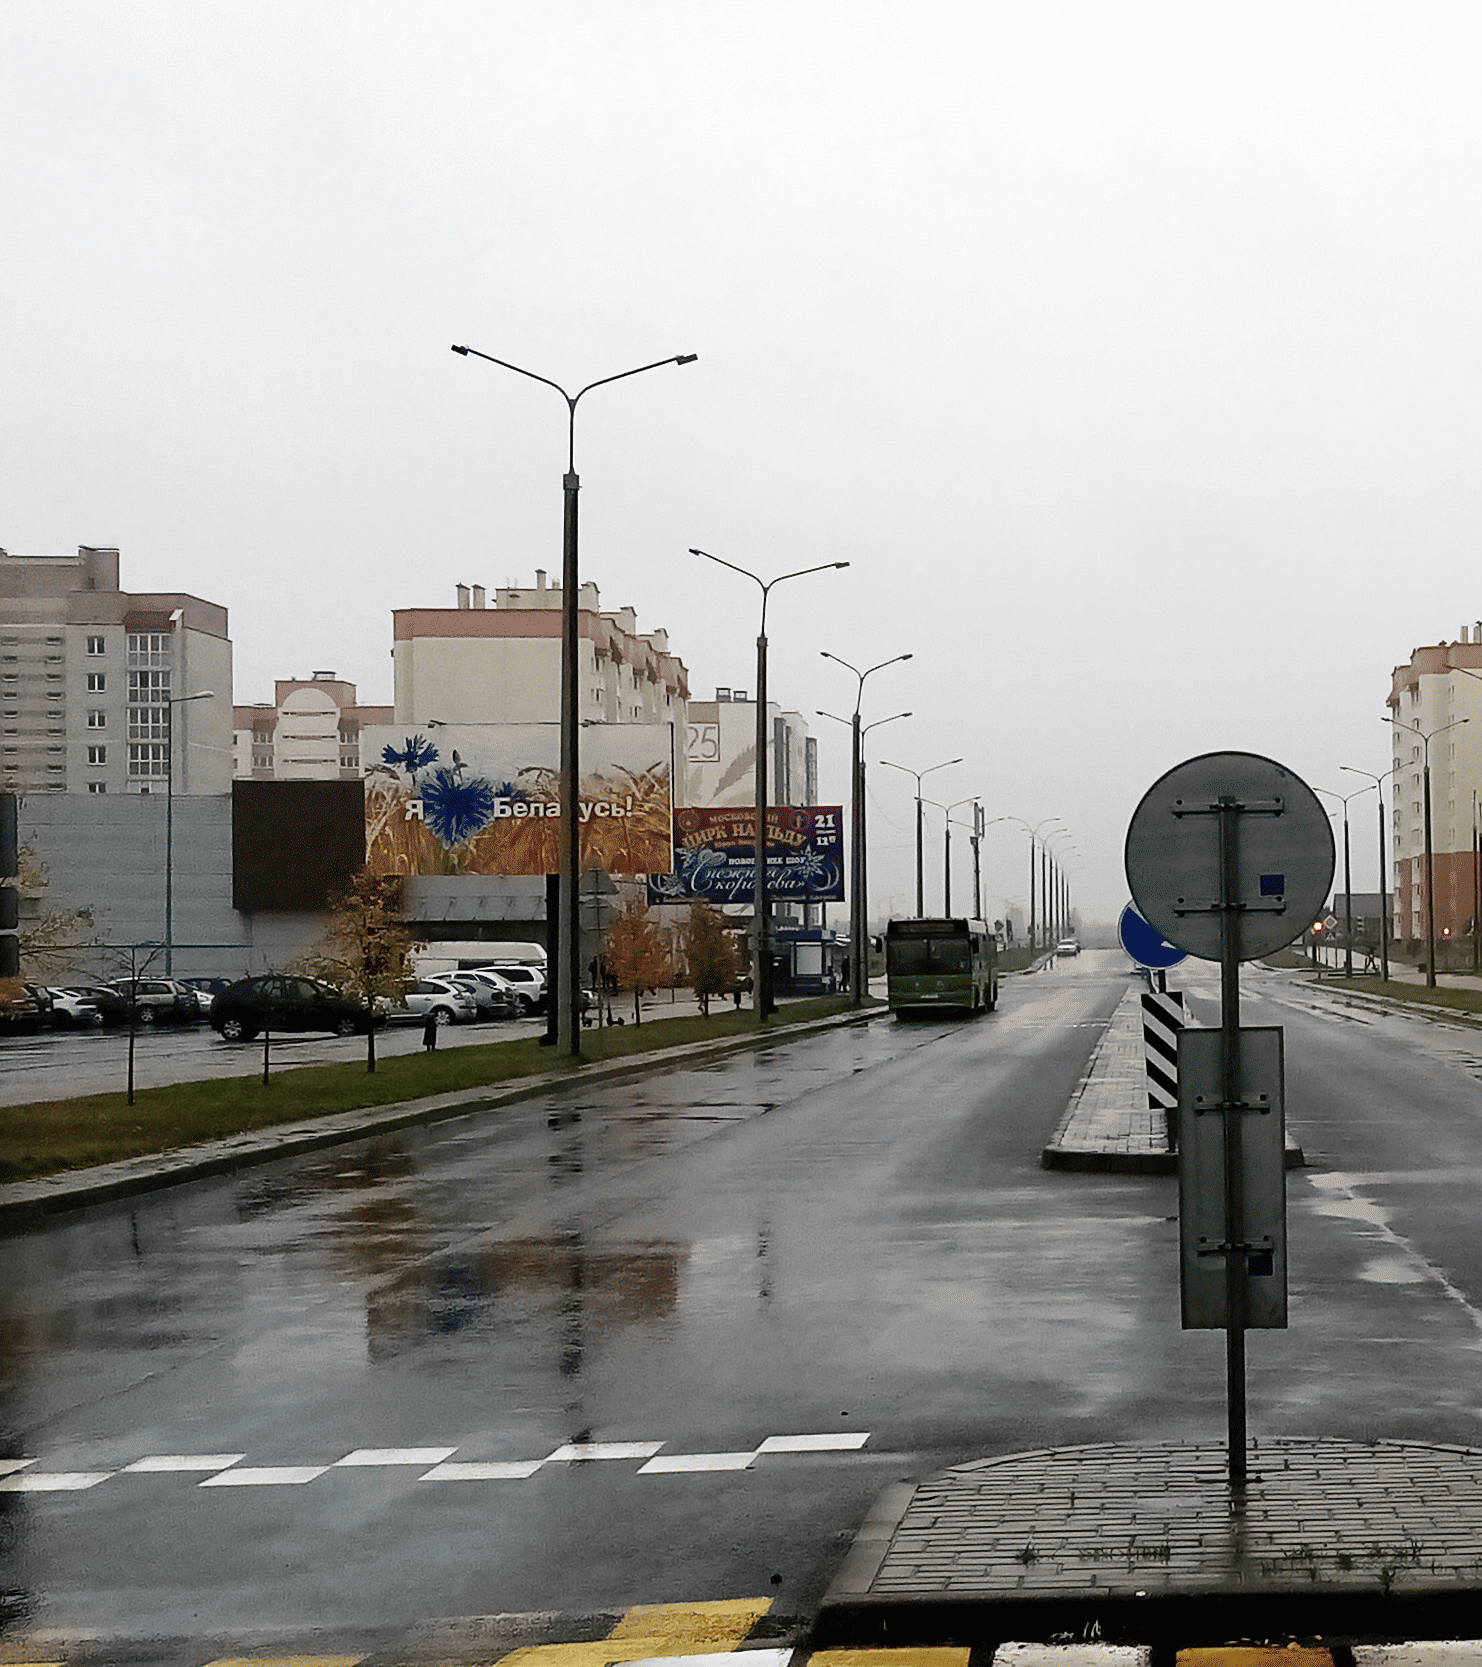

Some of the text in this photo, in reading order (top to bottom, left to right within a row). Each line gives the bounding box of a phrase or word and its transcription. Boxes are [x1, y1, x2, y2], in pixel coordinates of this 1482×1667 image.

[404, 796, 633, 823] Я Белаусь!
[815, 814, 835, 827] 21
[682, 825, 728, 849] ЦИРК
[732, 823, 756, 837] НА
